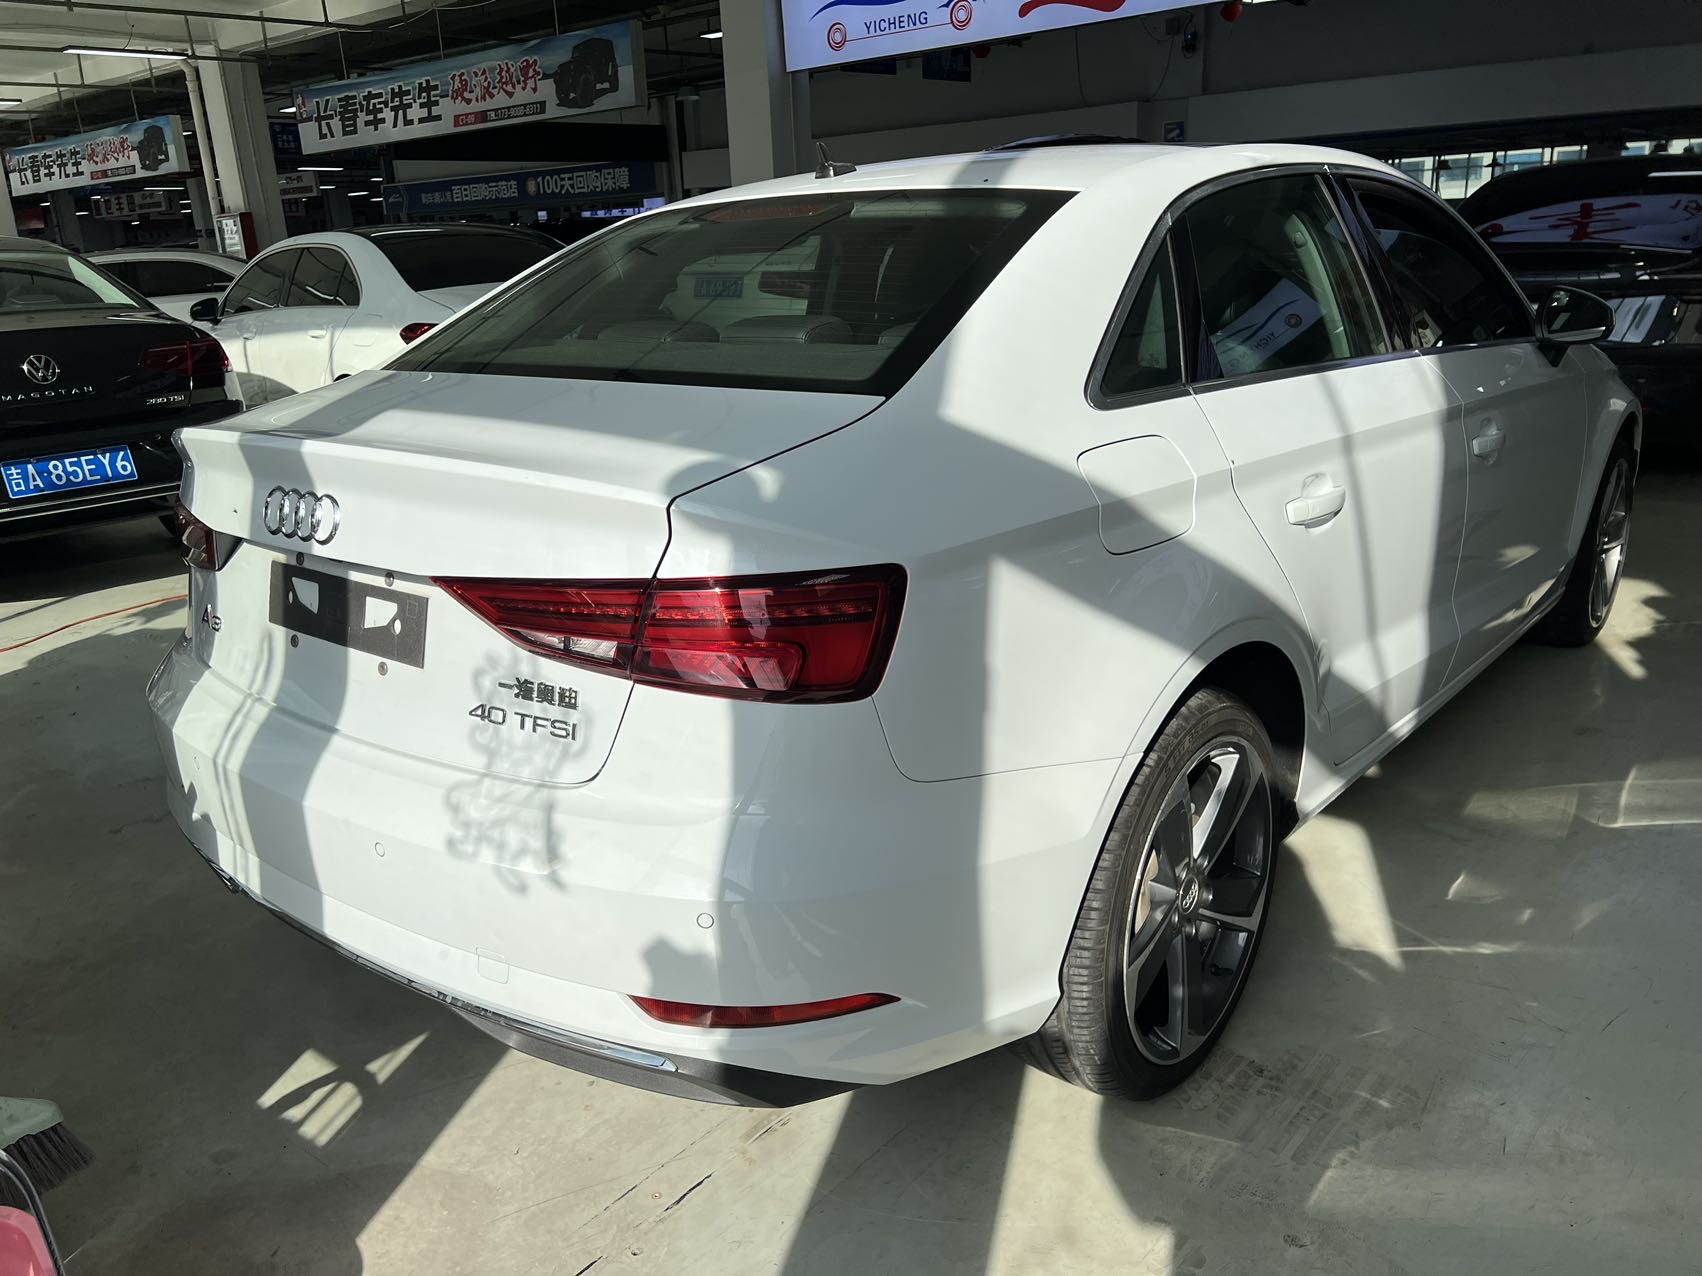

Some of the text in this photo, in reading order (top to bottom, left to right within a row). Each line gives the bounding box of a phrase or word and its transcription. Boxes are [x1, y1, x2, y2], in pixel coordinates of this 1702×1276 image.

[864, 11, 928, 35] YICHENG
[314, 79, 442, 140] 长春车先生
[449, 58, 542, 105] 硬派越野
[16, 147, 85, 186] 长春车先生
[452, 180, 518, 202] 百日回购示范店
[537, 167, 631, 195] 100天回购保障
[1, 386, 93, 401] MAGOTAN
[168, 394, 185, 402] TSI
[498, 677, 578, 710] 一汽奥迪
[468, 703, 578, 741] 40 TFSI
